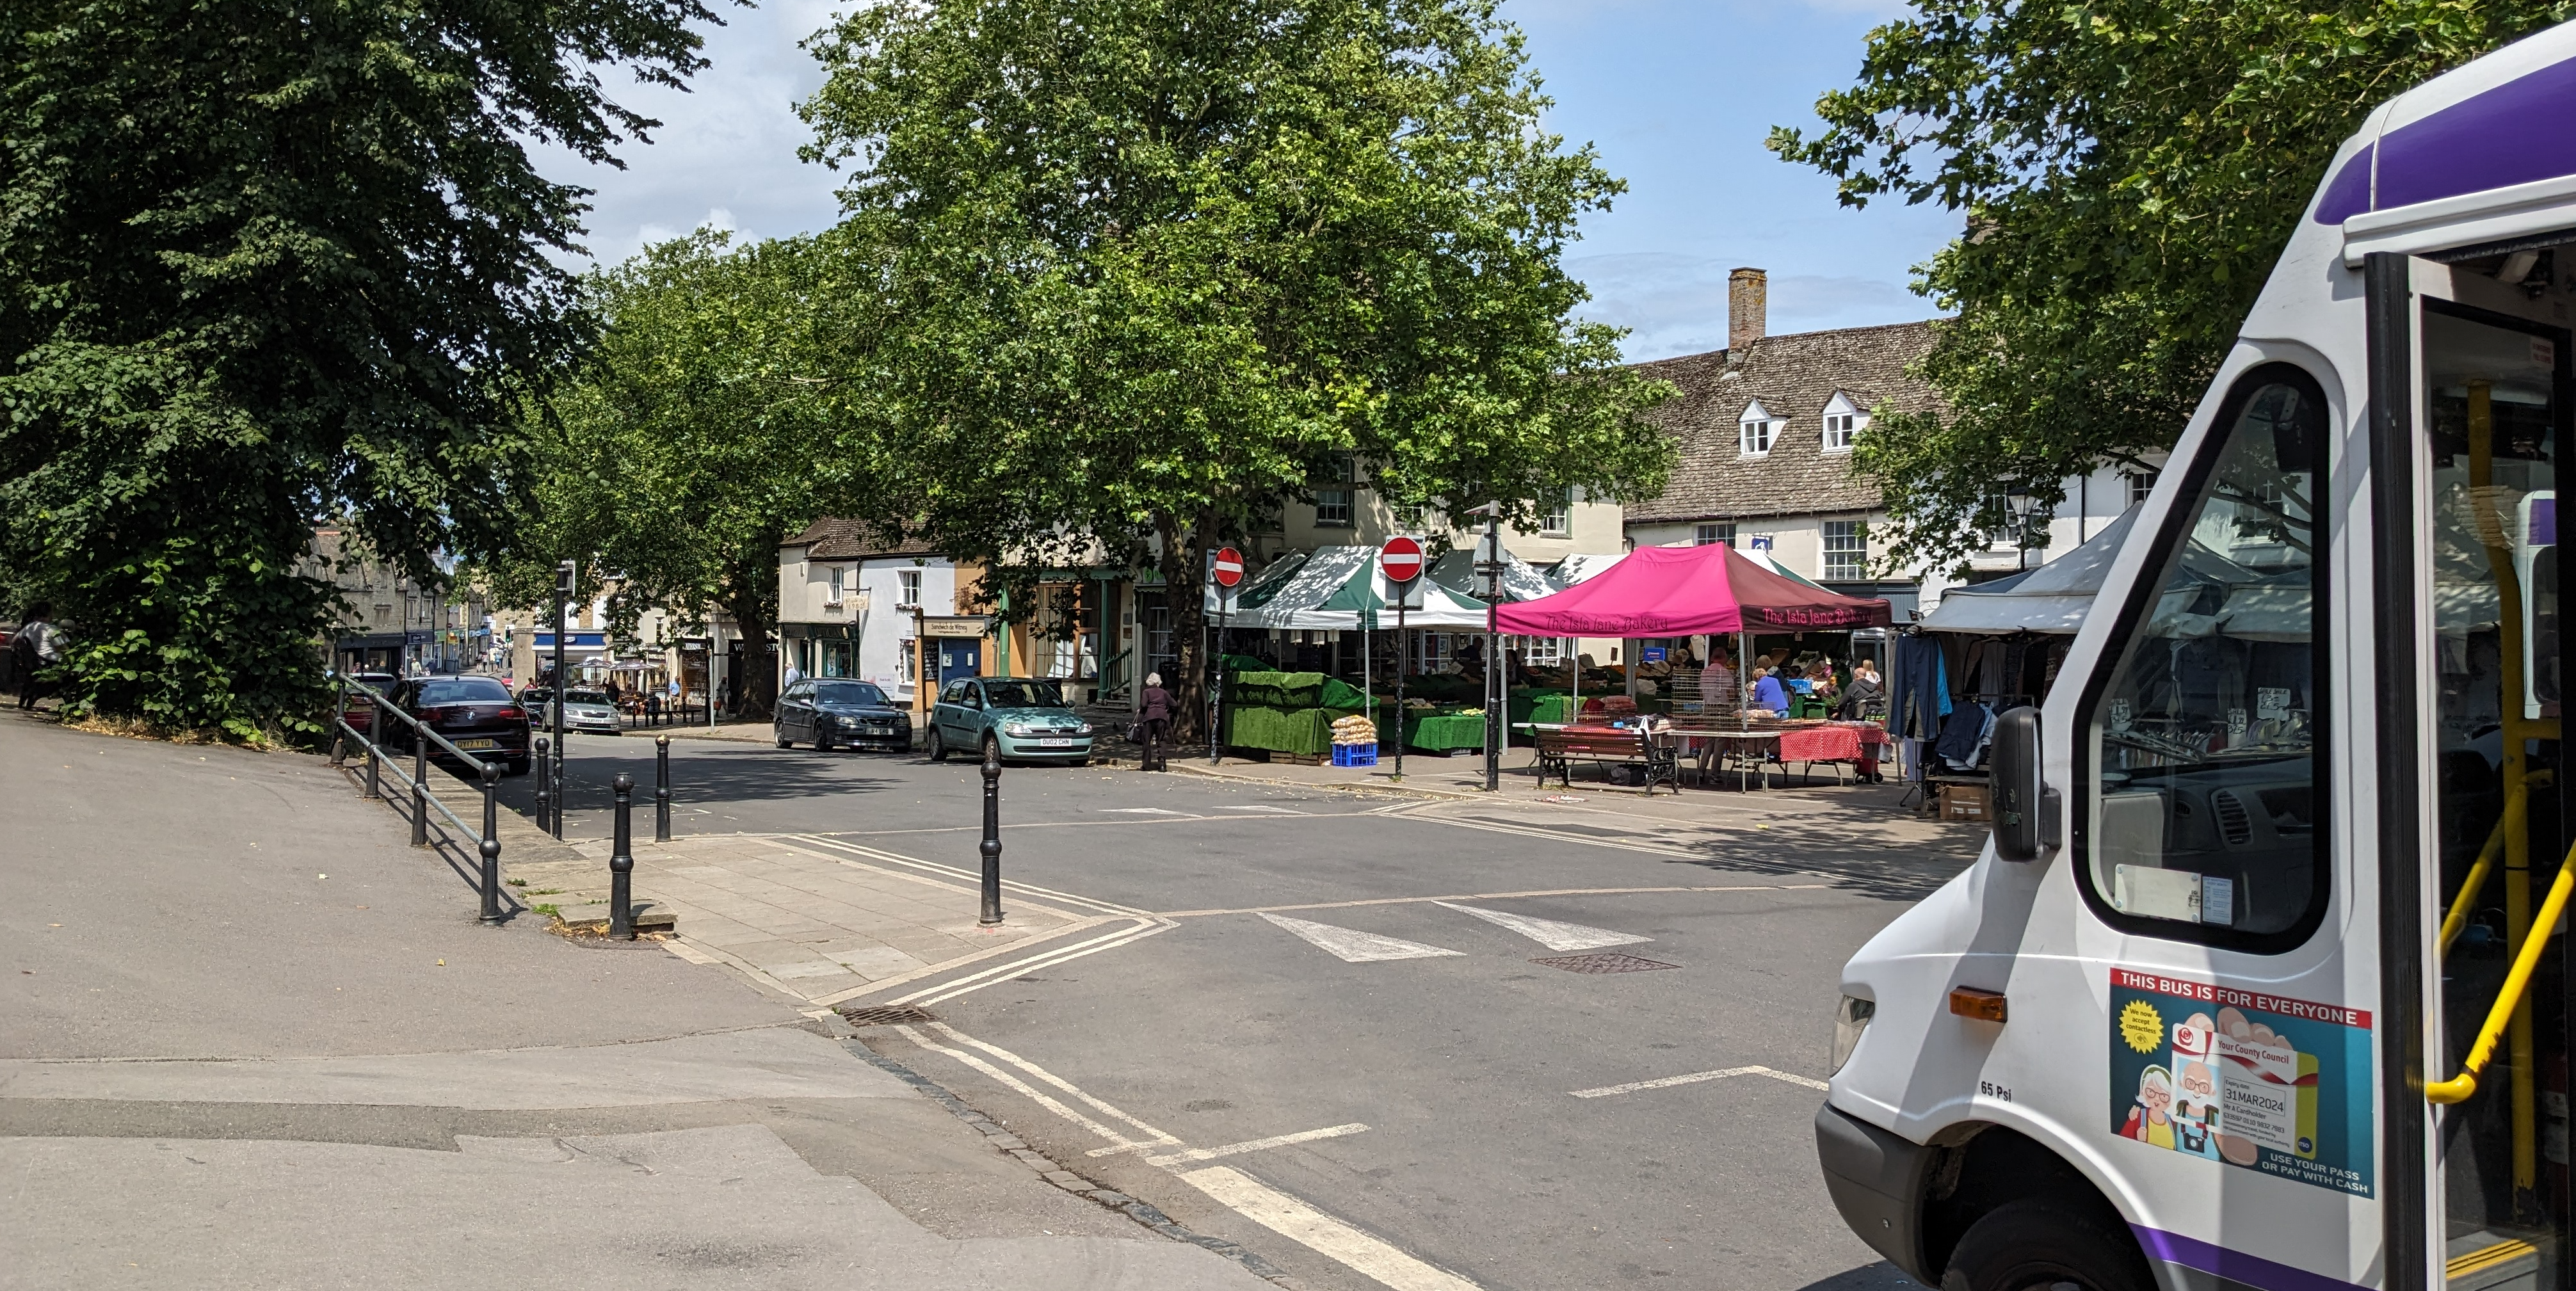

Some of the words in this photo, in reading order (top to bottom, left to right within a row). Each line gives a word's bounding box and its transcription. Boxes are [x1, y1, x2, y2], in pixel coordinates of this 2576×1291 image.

[931, 621, 949, 630] Sandwich
[1545, 616, 1566, 630] The
[1569, 616, 1590, 630] Isla
[1593, 617, 1619, 632] Jane
[1622, 616, 1668, 632] Bakery
[1762, 608, 1784, 624] The
[1786, 609, 1807, 624] Isla
[1809, 609, 1834, 625] Jane
[1835, 608, 1873, 625] Bakery
[2121, 972, 2155, 990] THIS
[2160, 979, 2193, 996] BUS
[2197, 986, 2212, 1000] IS
[2217, 989, 2251, 1007] FOR
[2257, 995, 2357, 1025] EVERYONE
[2125, 1023, 2156, 1034] contactless
[2132, 1017, 2150, 1025] accept
[2218, 1039, 2234, 1050] Your
[2235, 1044, 2260, 1059] County
[2262, 1050, 2289, 1064] Council
[1981, 1080, 1993, 1097] 65
[1997, 1085, 2011, 1103] Psi
[2226, 1089, 2283, 1112] 31MAR2024
[2236, 1106, 2267, 1119] Cardholder
[2270, 1153, 2292, 1165] USE
[2294, 1158, 2327, 1173] YOUR
[2330, 1167, 2360, 1181] PASS
[2262, 1161, 2278, 1172] OR
[2280, 1166, 2301, 1176] PAY
[2303, 1171, 2333, 1185] WITH
[2336, 1179, 2368, 1194] CASH
